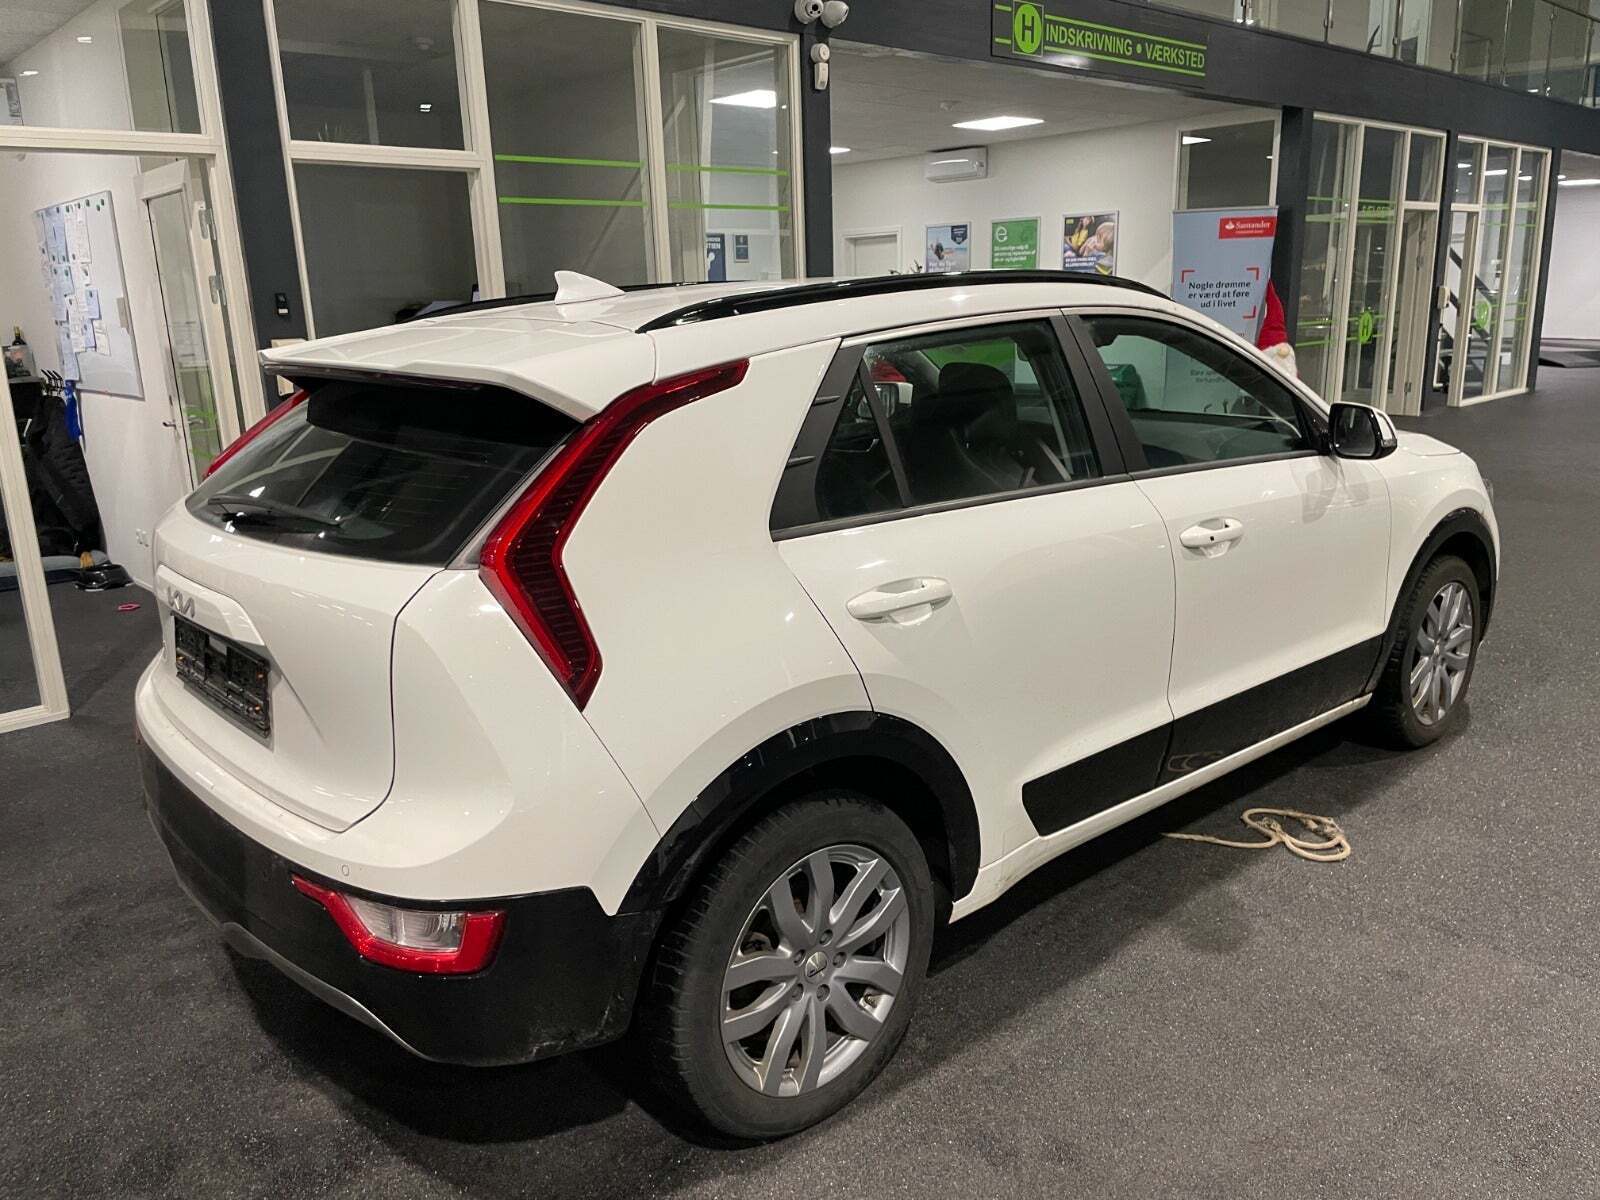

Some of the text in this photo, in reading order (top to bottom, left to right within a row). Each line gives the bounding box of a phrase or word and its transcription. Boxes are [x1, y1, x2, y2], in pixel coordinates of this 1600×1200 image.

[1046, 23, 1205, 69] INDSKRIVNING VÆRKSTED
[1236, 220, 1270, 230] Santander
[1188, 280, 1251, 291] Nogle drømme
[1199, 290, 1221, 299] værd
[1232, 289, 1250, 298] føre
[1200, 299, 1211, 308] ud
[1217, 299, 1236, 307] livet
